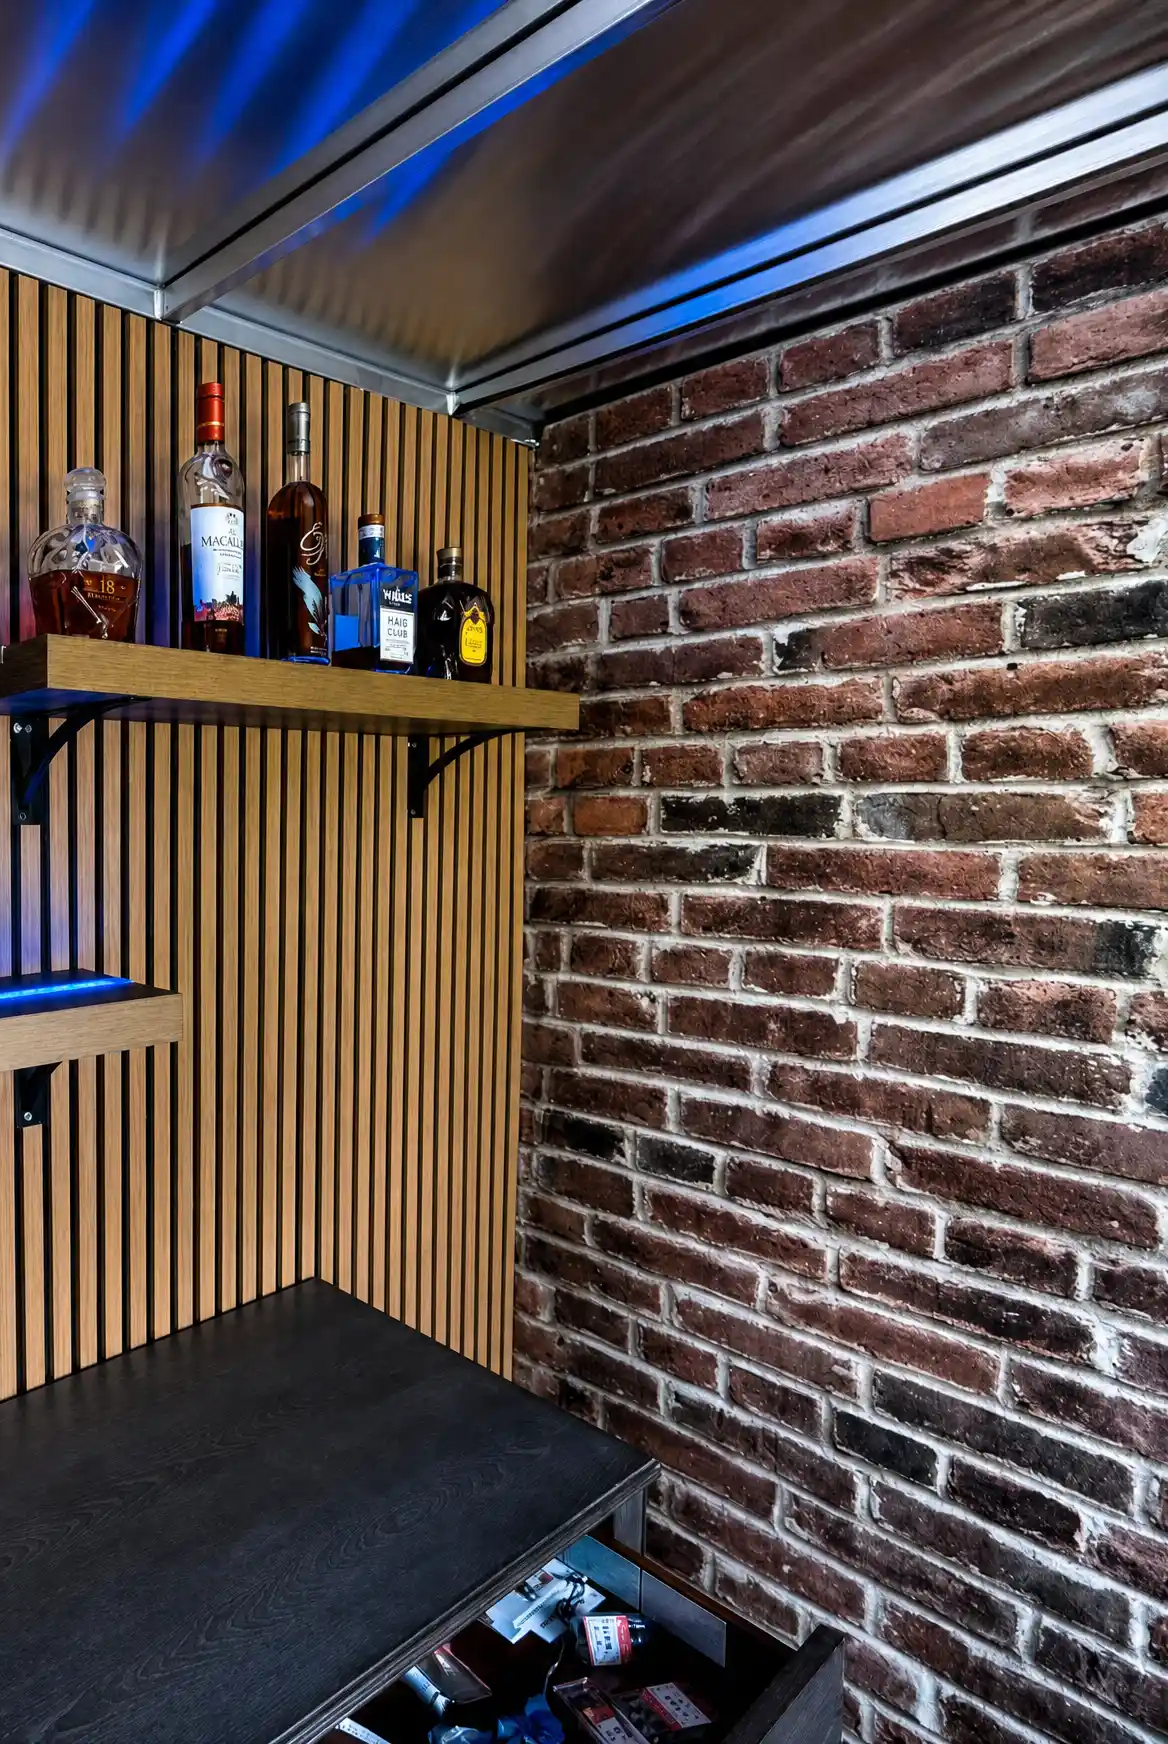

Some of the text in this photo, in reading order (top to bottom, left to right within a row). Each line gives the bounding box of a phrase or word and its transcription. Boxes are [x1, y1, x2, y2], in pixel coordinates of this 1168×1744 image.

[100, 577, 115, 594] 18
[387, 616, 408, 628] HAIG
[387, 628, 408, 638] CLUB
